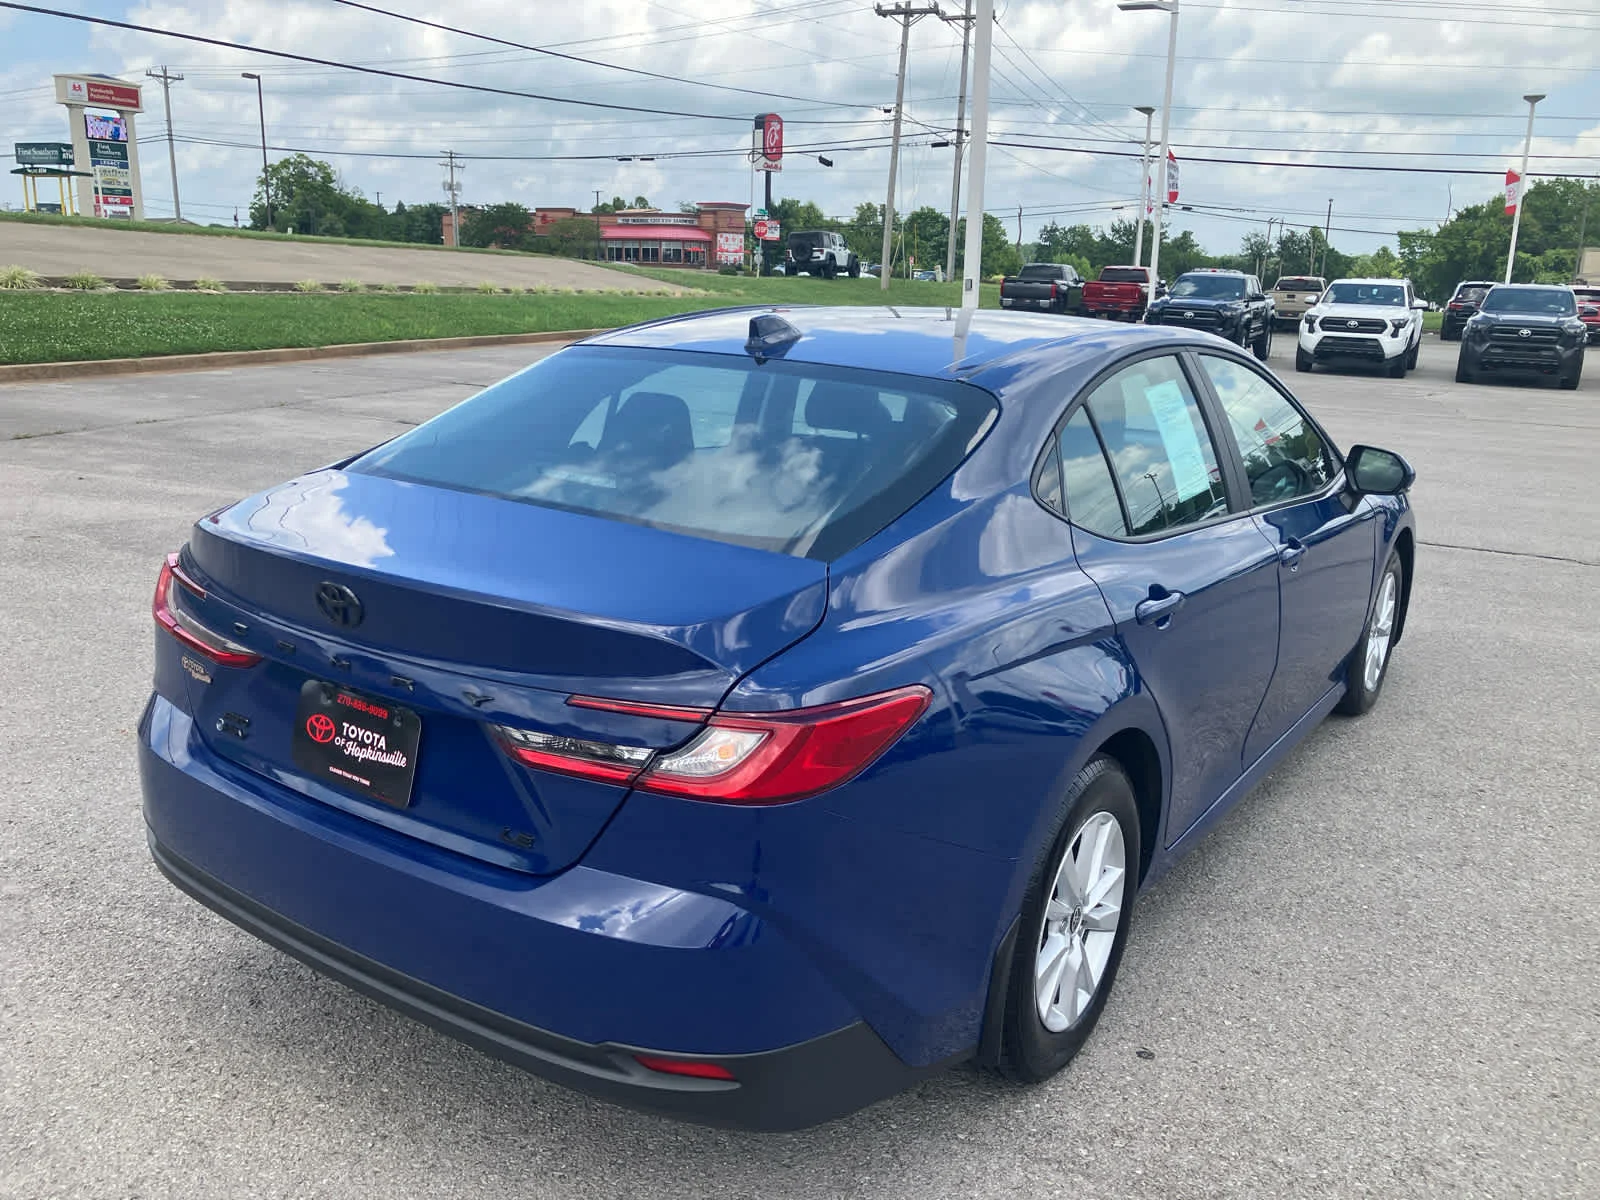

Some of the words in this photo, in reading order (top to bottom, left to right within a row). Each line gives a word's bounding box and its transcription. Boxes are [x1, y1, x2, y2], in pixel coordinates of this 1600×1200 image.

[342, 722, 386, 750] TOYOTA
[334, 736, 346, 747] OF
[343, 740, 407, 768] Hopkinsville
